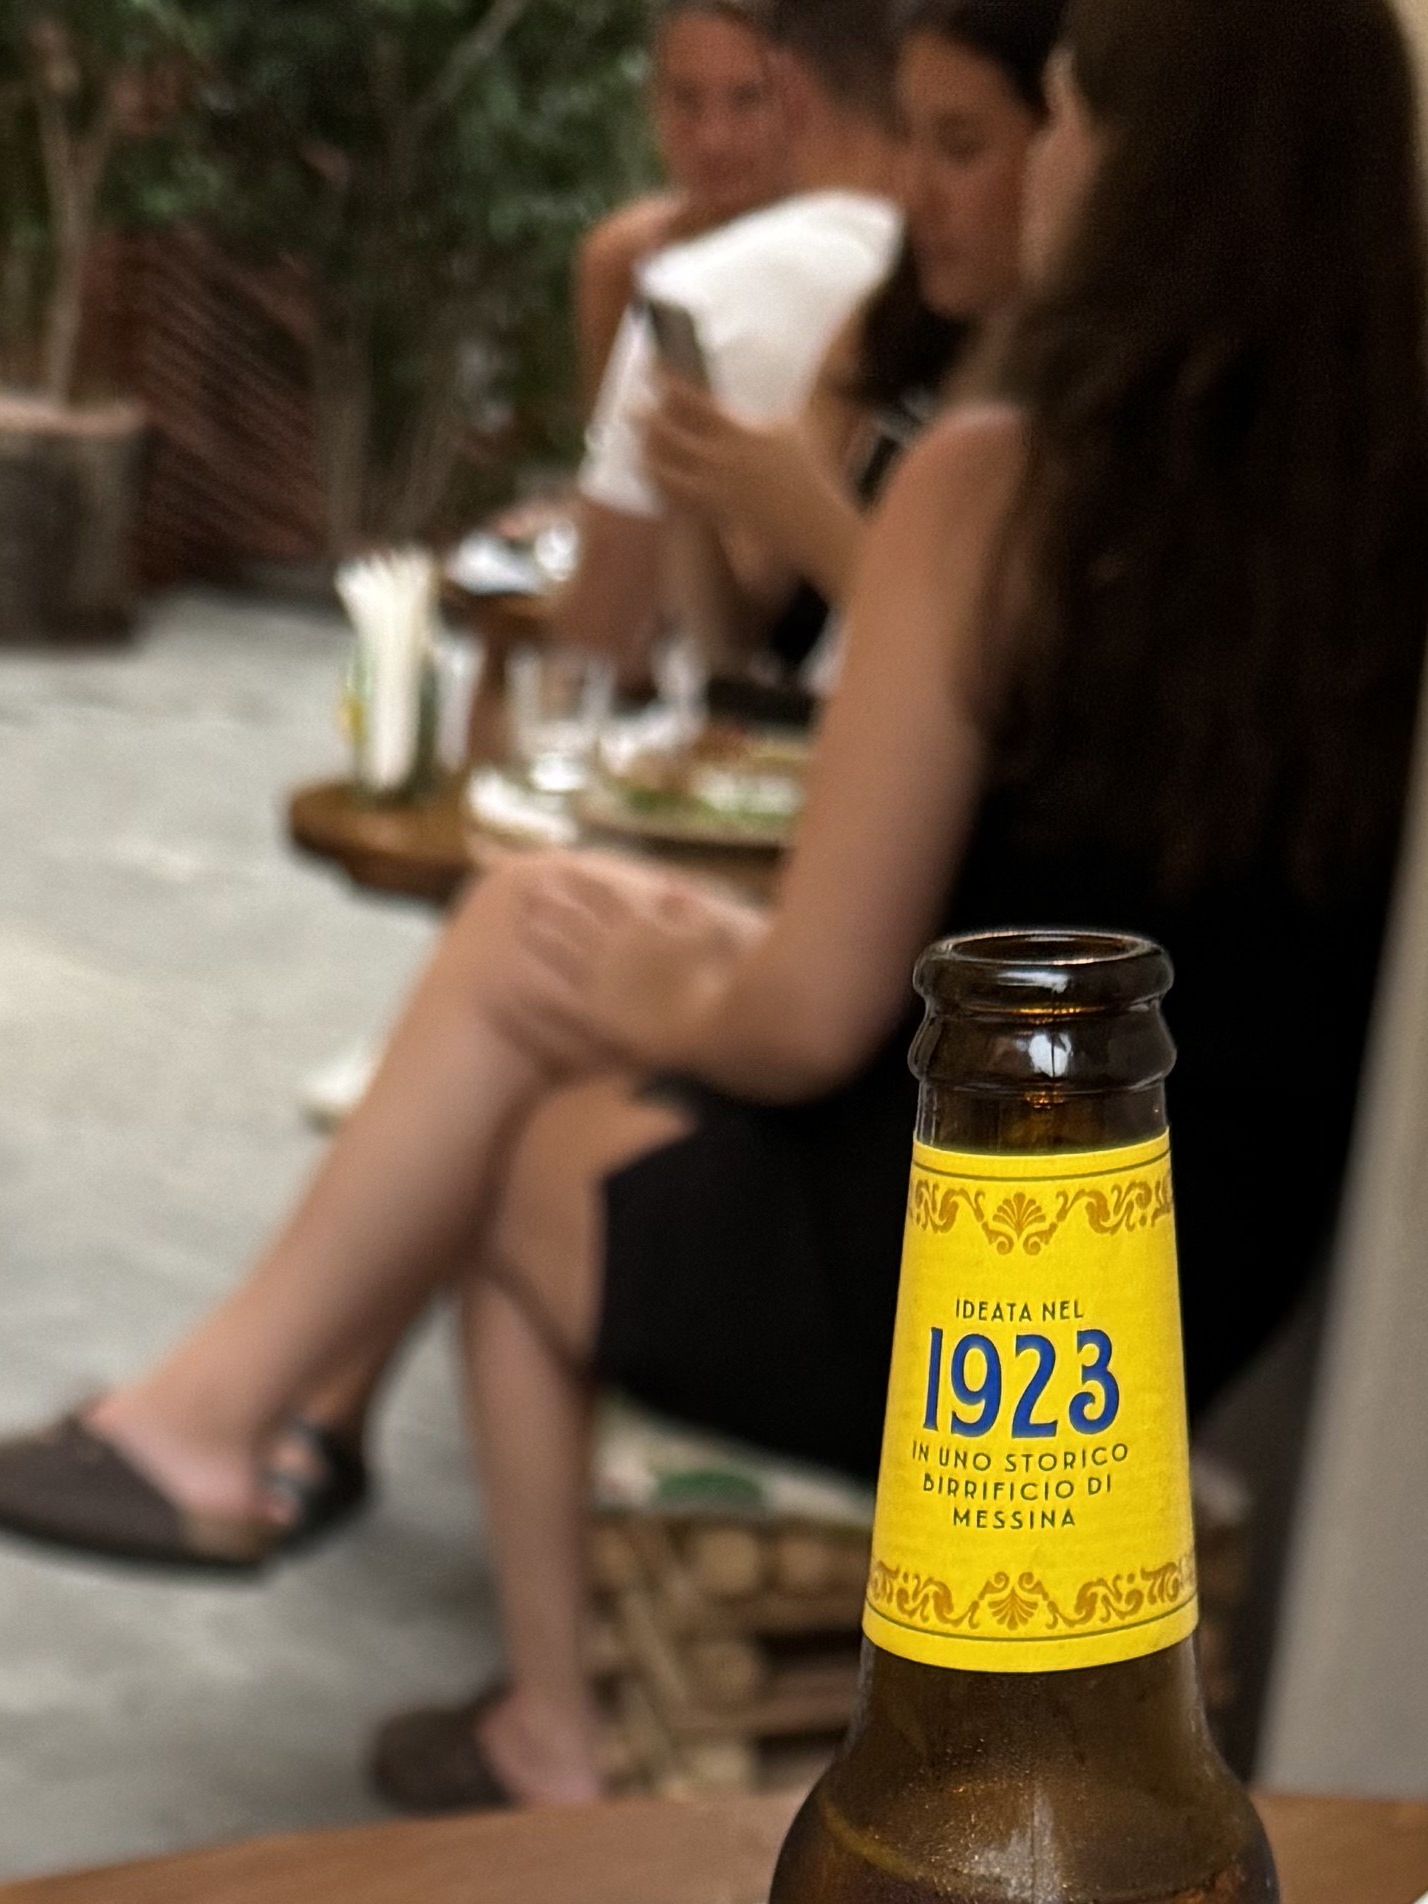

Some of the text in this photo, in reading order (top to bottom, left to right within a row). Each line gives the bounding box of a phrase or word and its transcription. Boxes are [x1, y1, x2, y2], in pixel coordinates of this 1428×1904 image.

[955, 1298, 1084, 1322] IDEATA NEL
[923, 1327, 1120, 1439] 1923
[912, 1440, 1128, 1473] IN UNO STORICO
[923, 1472, 1112, 1502] BIRRIFICIO DI
[953, 1506, 1076, 1530] MESSINA
